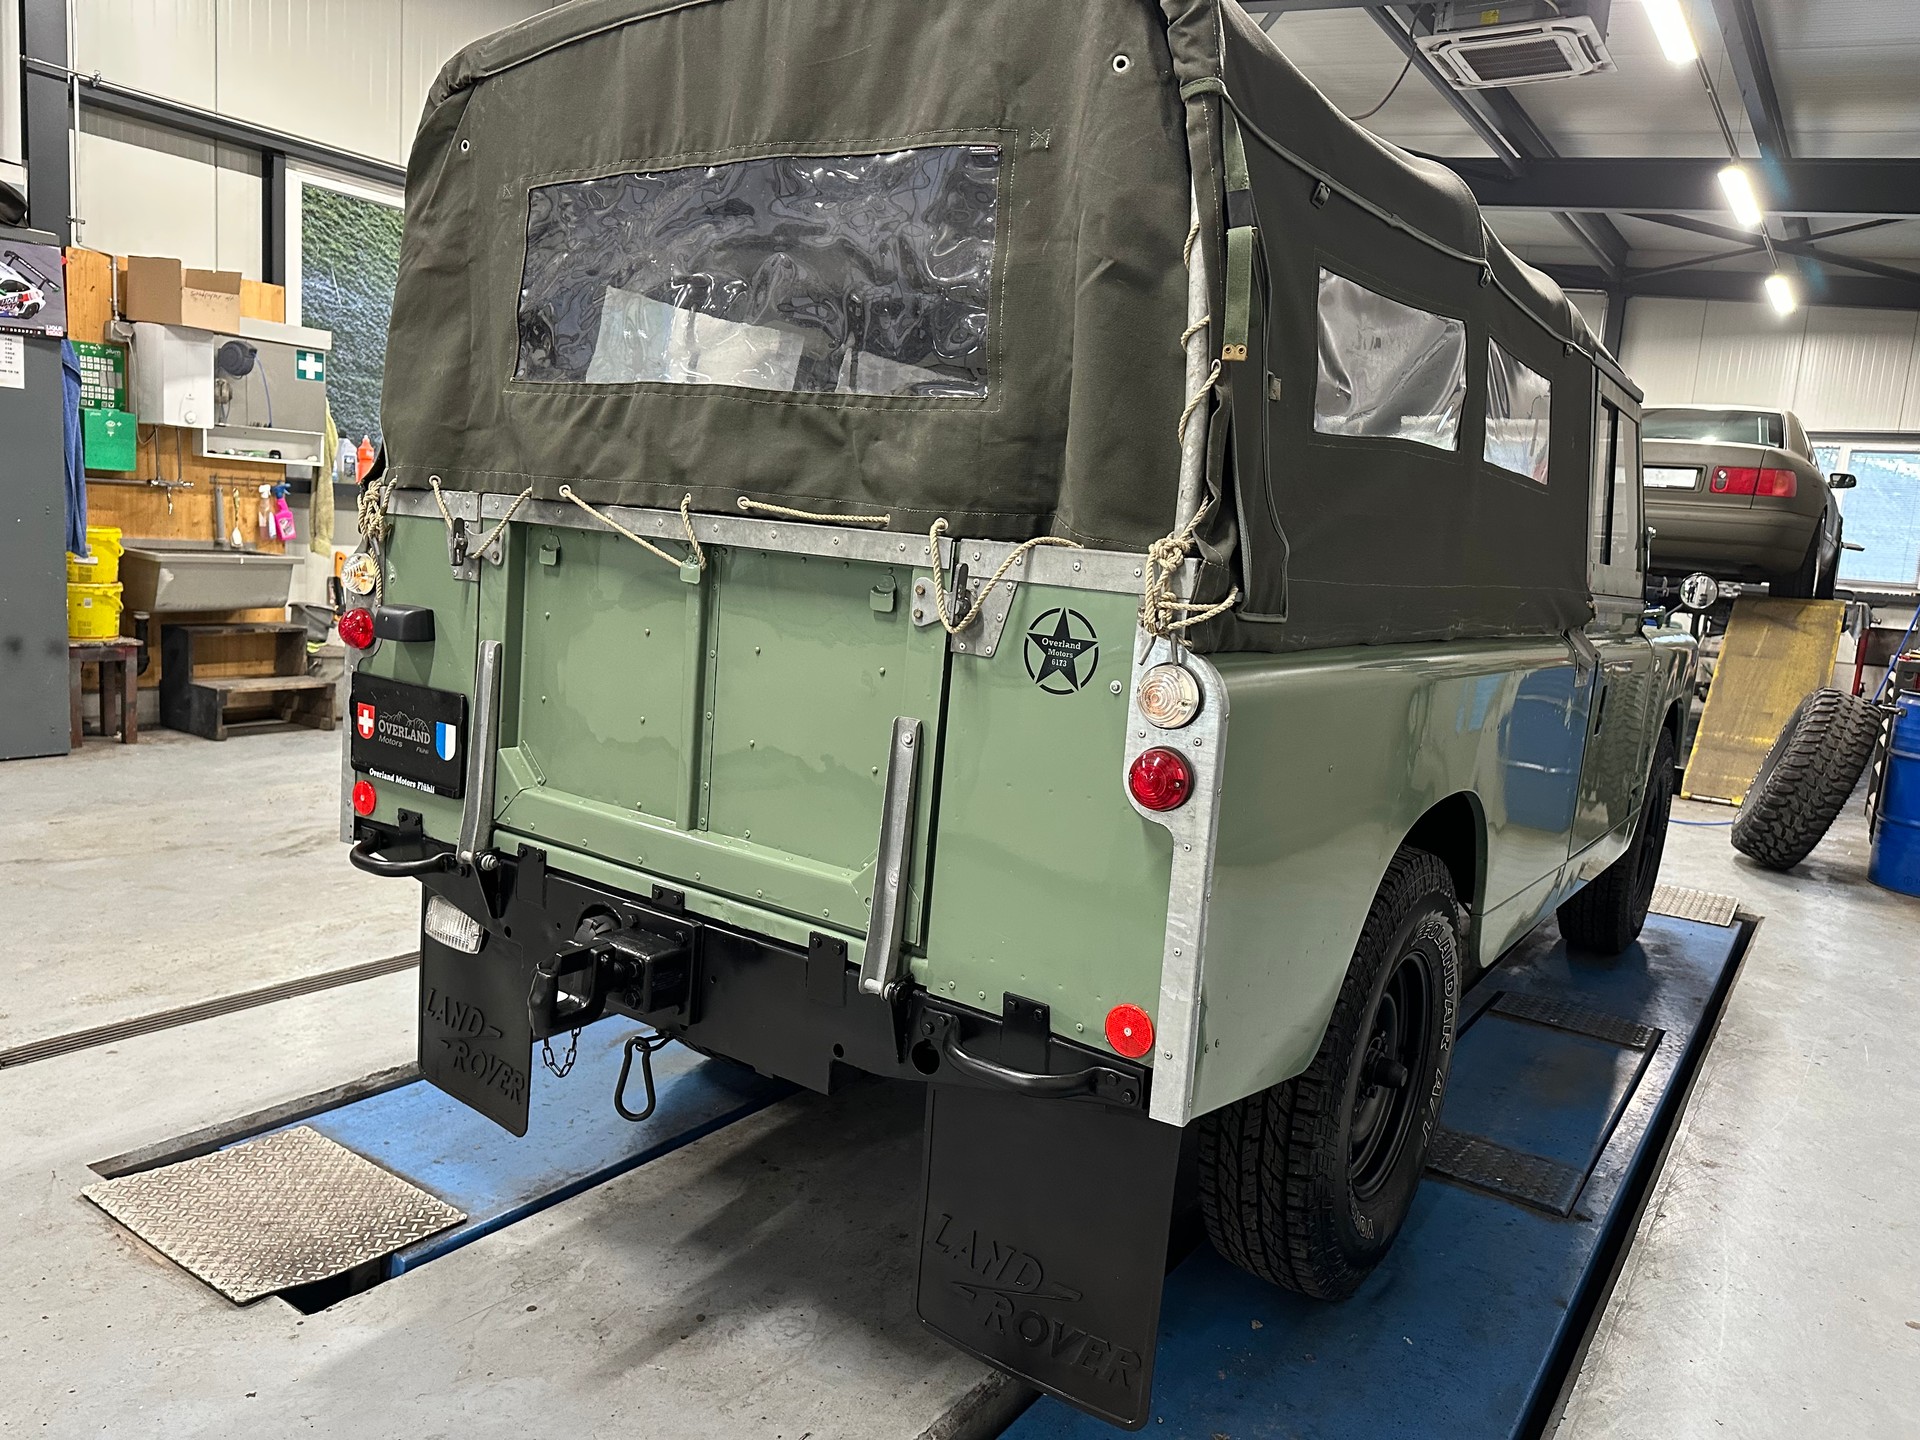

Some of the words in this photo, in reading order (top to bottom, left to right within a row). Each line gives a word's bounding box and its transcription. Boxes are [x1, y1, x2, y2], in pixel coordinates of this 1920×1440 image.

[1041, 637, 1081, 650] Overland
[1047, 648, 1073, 658] Motors
[1051, 658, 1067, 667] 6173
[378, 719, 431, 745] OVERLAND
[378, 735, 403, 748] Motors
[369, 767, 395, 782] Overland
[395, 775, 416, 789] Motors
[426, 988, 485, 1038] LAND
[453, 1039, 526, 1105] ROVER
[935, 1213, 1044, 1293] LAND
[984, 1291, 1143, 1390] ROVER
